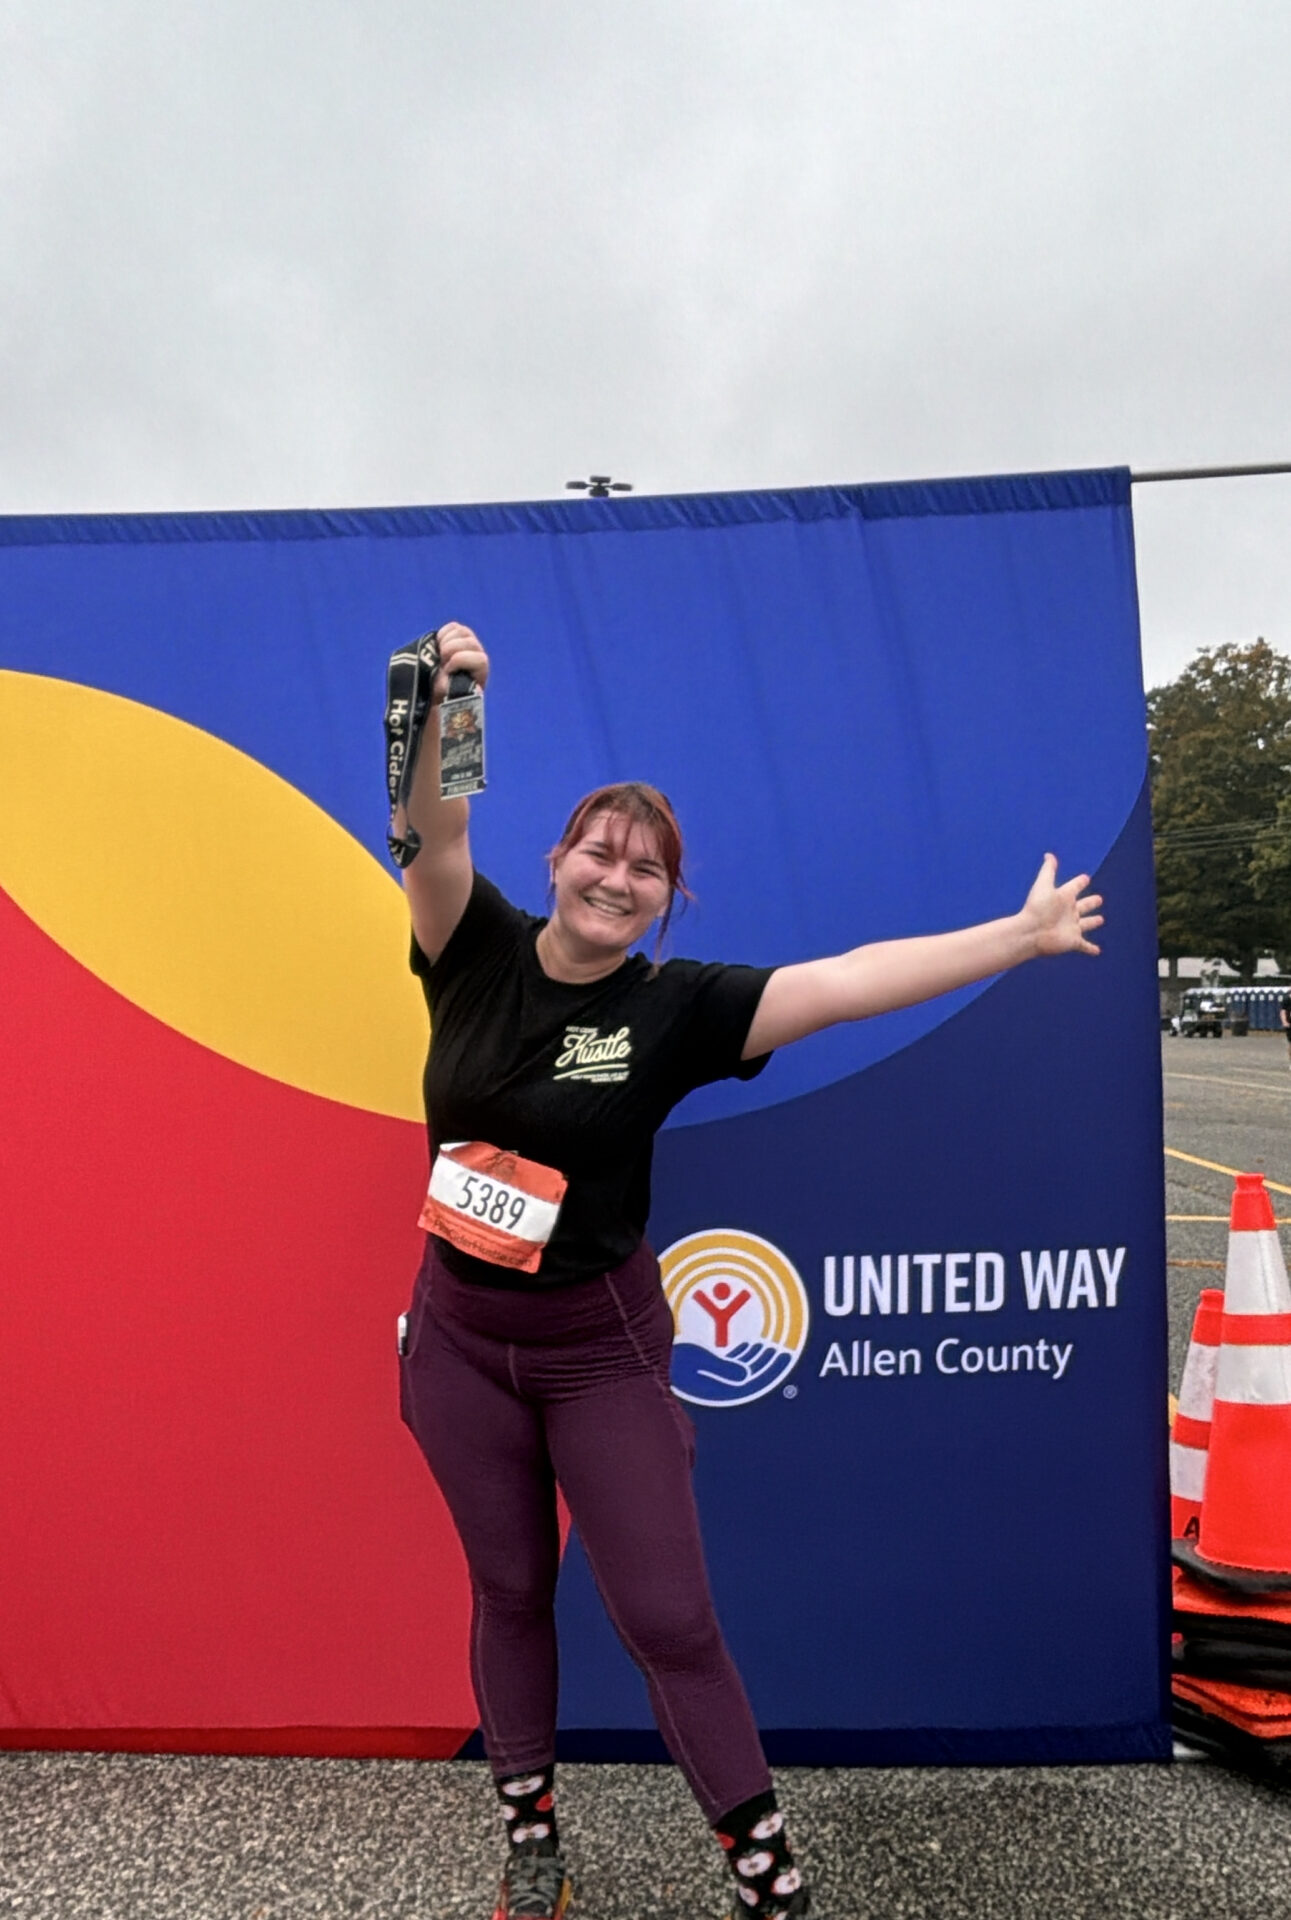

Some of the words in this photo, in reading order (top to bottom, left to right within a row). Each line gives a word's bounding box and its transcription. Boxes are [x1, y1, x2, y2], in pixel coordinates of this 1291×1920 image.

[389, 699, 408, 735] Hot
[388, 740, 405, 799] Cider
[555, 1026, 631, 1068] Hustle
[456, 1175, 526, 1230] 5389
[823, 1251, 1005, 1317] UNITED
[1020, 1247, 1126, 1311] WAY
[819, 1340, 922, 1378] Allen
[935, 1338, 1074, 1380] County
